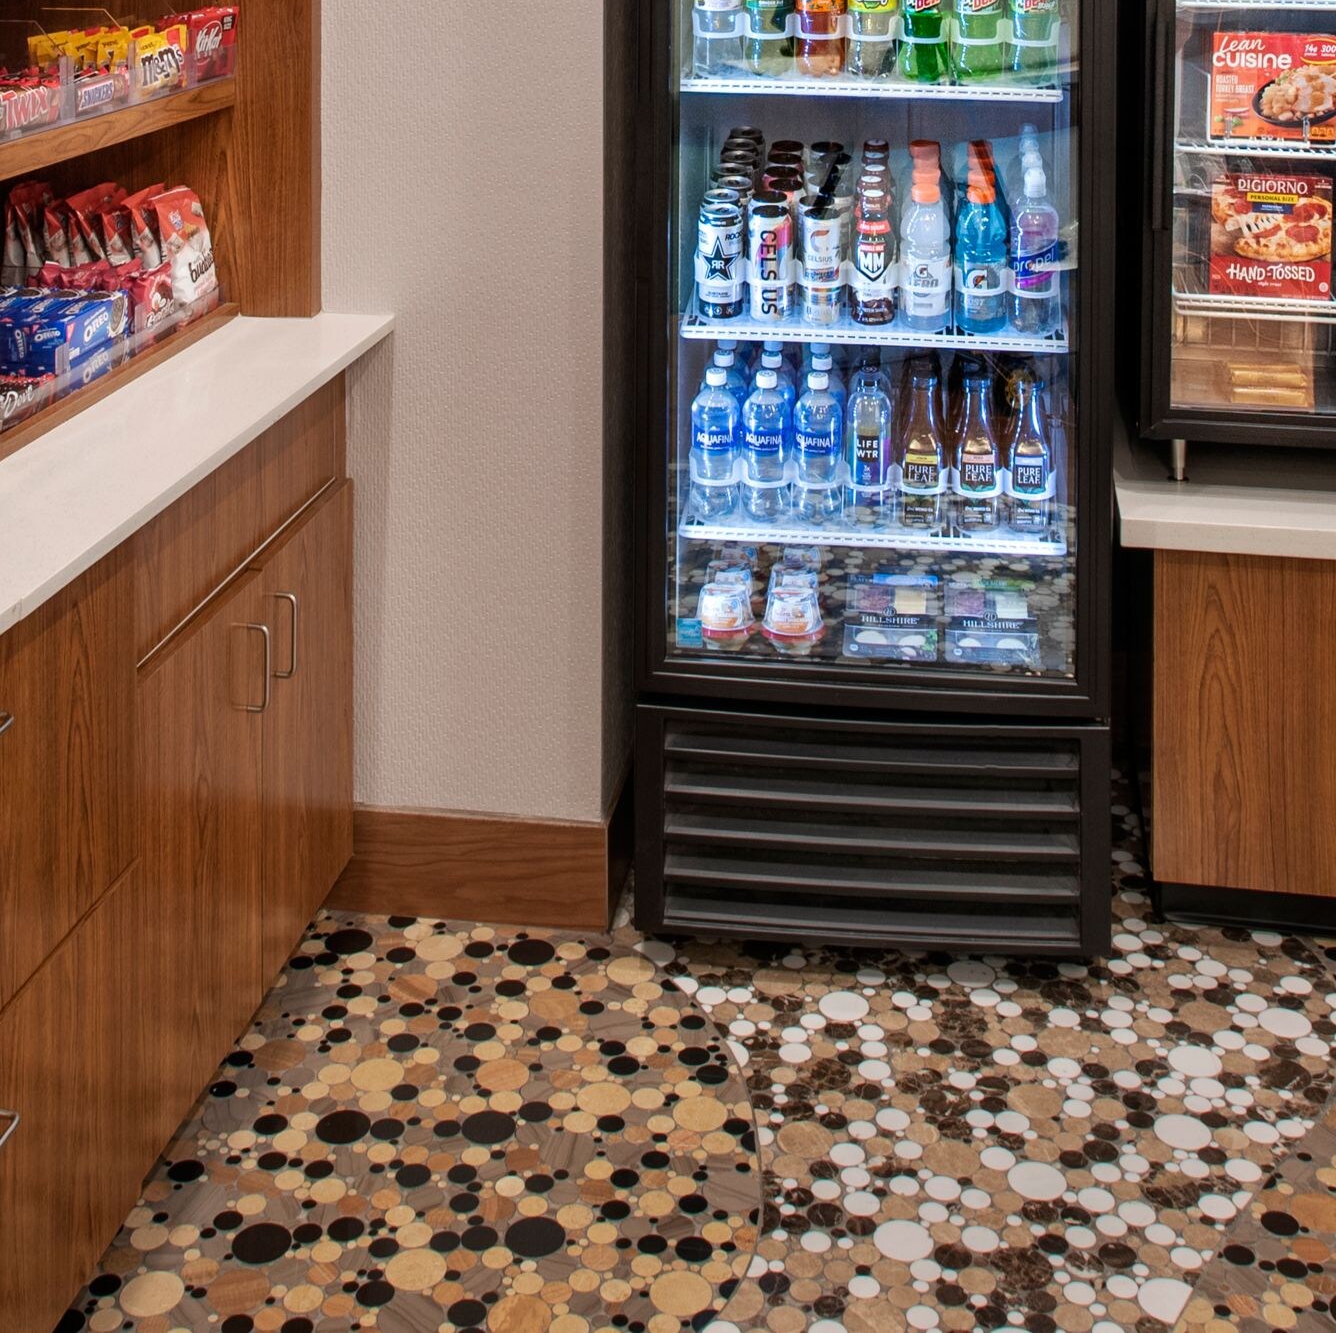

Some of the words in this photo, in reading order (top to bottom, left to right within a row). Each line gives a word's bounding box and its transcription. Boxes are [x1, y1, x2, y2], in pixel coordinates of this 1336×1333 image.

[1219, 36, 1266, 53] Lean
[2, 87, 48, 130] TWIX
[760, 230, 778, 315] CELSUS
[1226, 263, 1316, 283] HAND-TOSSED
[84, 311, 109, 343] OREO
[83, 352, 109, 384] OREO
[696, 432, 734, 446] AQUAFINA
[745, 432, 782, 446] AQUAFINA
[856, 439, 879, 449] LIFE
[856, 449, 879, 459] WTR
[908, 465, 935, 474] PURE
[965, 464, 992, 473] PURE
[1017, 467, 1041, 476] PURE
[908, 473, 935, 482] LEAF
[965, 472, 992, 481] LEAF
[1017, 475, 1041, 484] LEAF
[861, 615, 919, 625] HILLSHIRE
[962, 620, 1021, 629] HILLSHIRE
